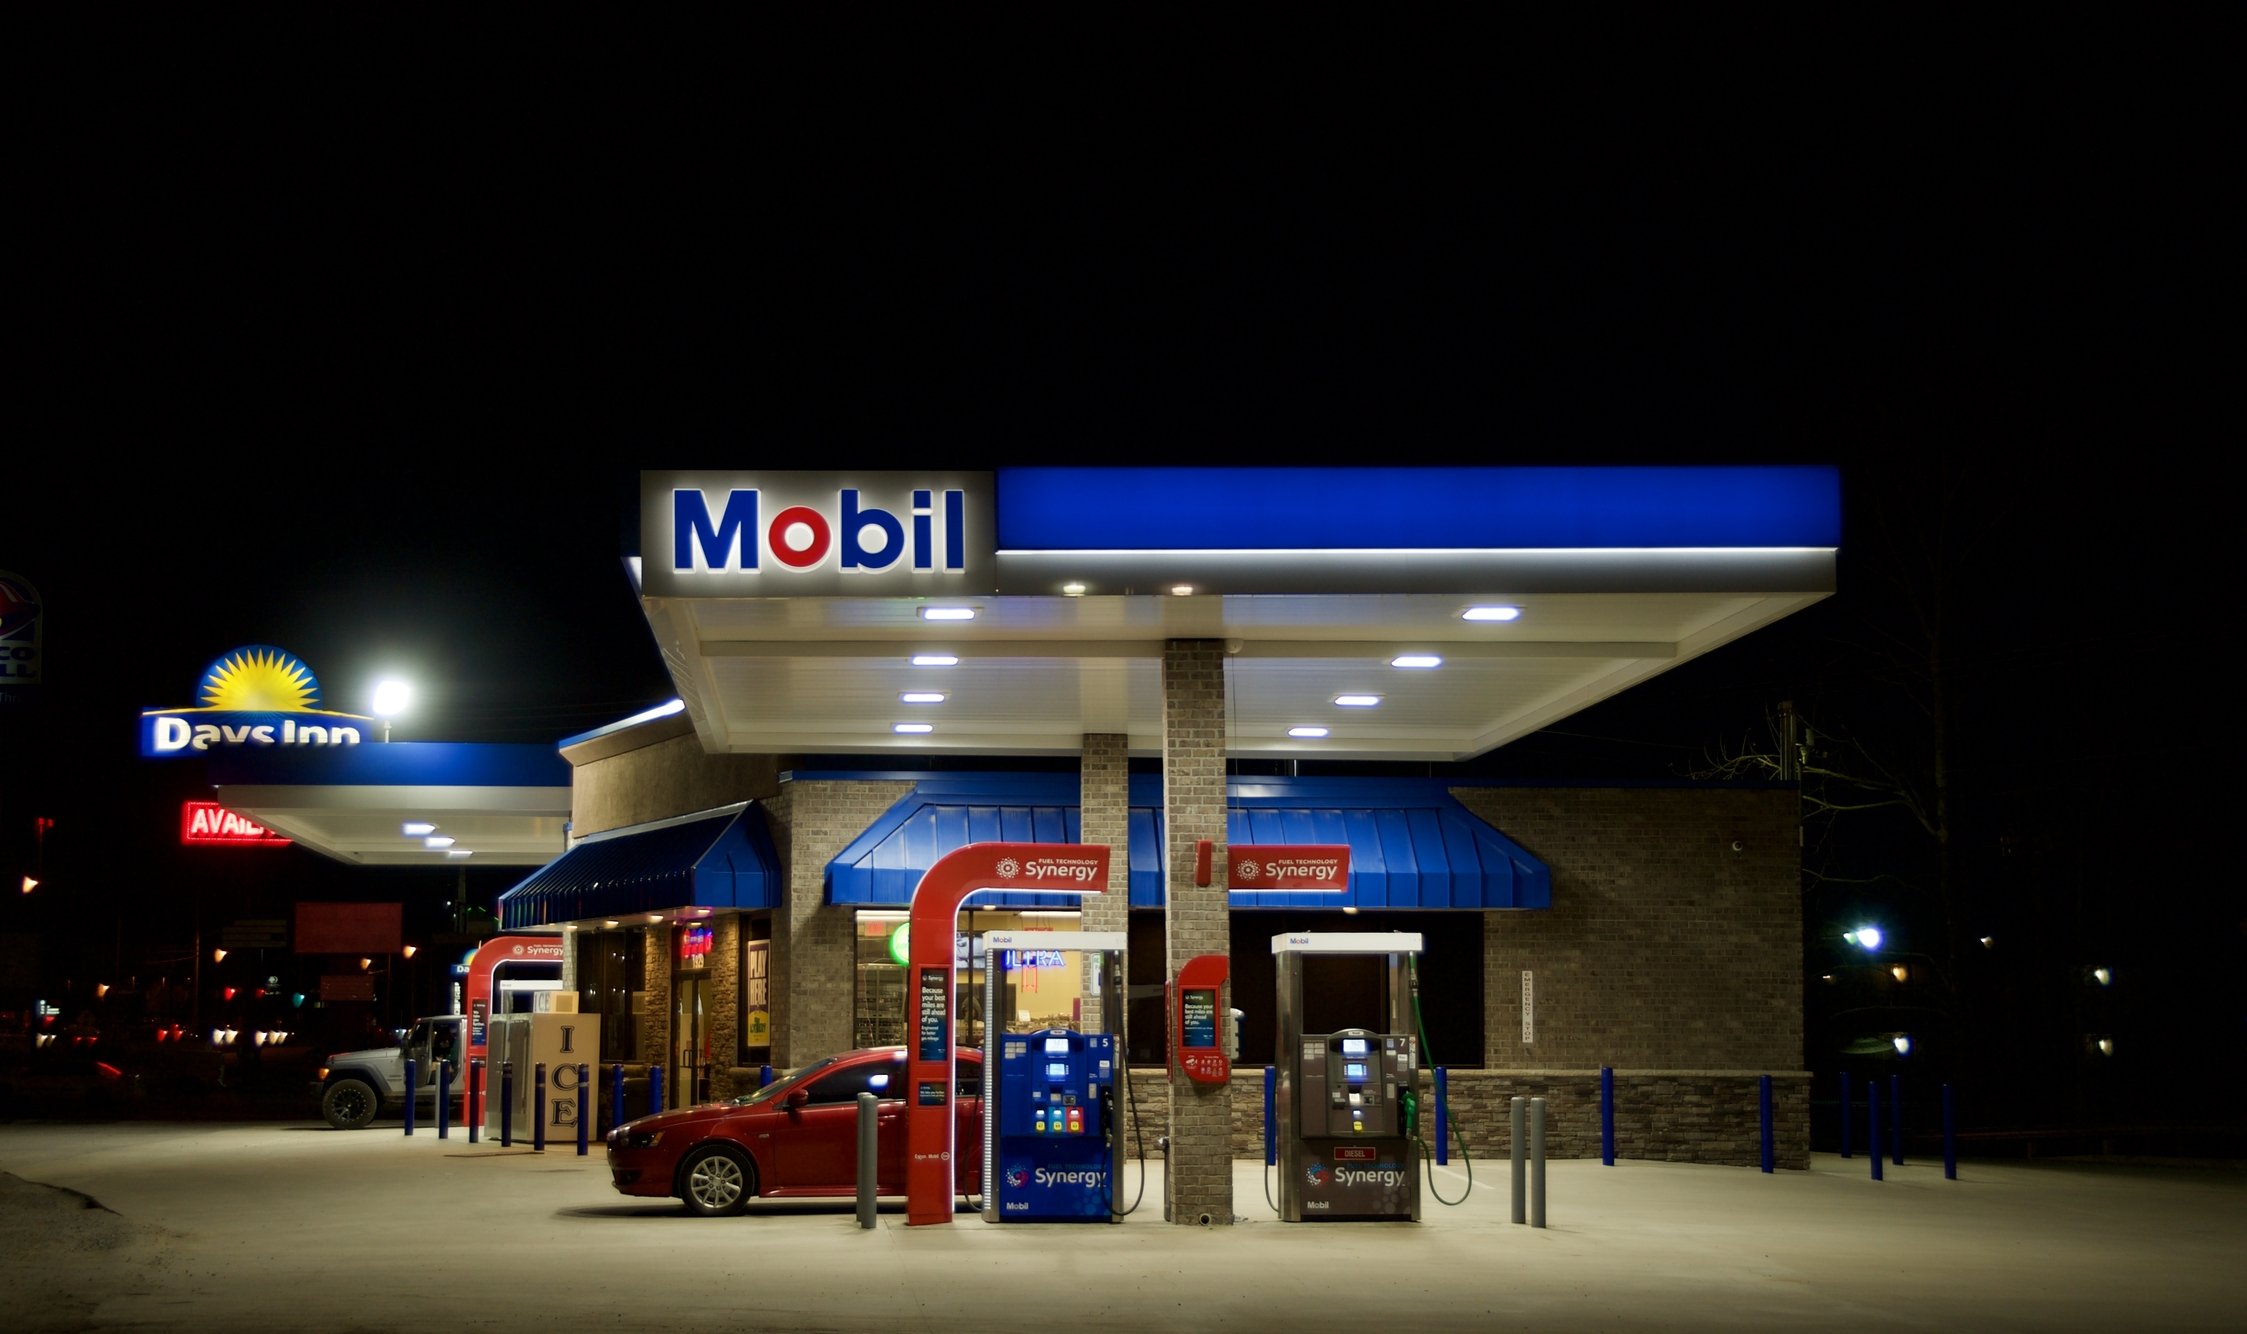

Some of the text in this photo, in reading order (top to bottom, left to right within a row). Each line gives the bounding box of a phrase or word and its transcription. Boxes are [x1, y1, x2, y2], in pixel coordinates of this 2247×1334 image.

[673, 488, 965, 572] Mobil
[284, 720, 361, 743] Inn
[1025, 861, 1098, 881] Synergy
[1265, 862, 1338, 881] Synergy
[527, 945, 564, 956] Synergy
[922, 986, 944, 994] Because
[1102, 1038, 1108, 1047] 5
[1399, 1038, 1406, 1047] 7
[550, 1025, 579, 1128] ICE
[1344, 1149, 1366, 1158] DIESEL
[1034, 1167, 1107, 1188] Synergy
[1334, 1166, 1406, 1187] Synergy
[1006, 1202, 1029, 1210] Mobil
[1307, 1201, 1329, 1209] Mobil
